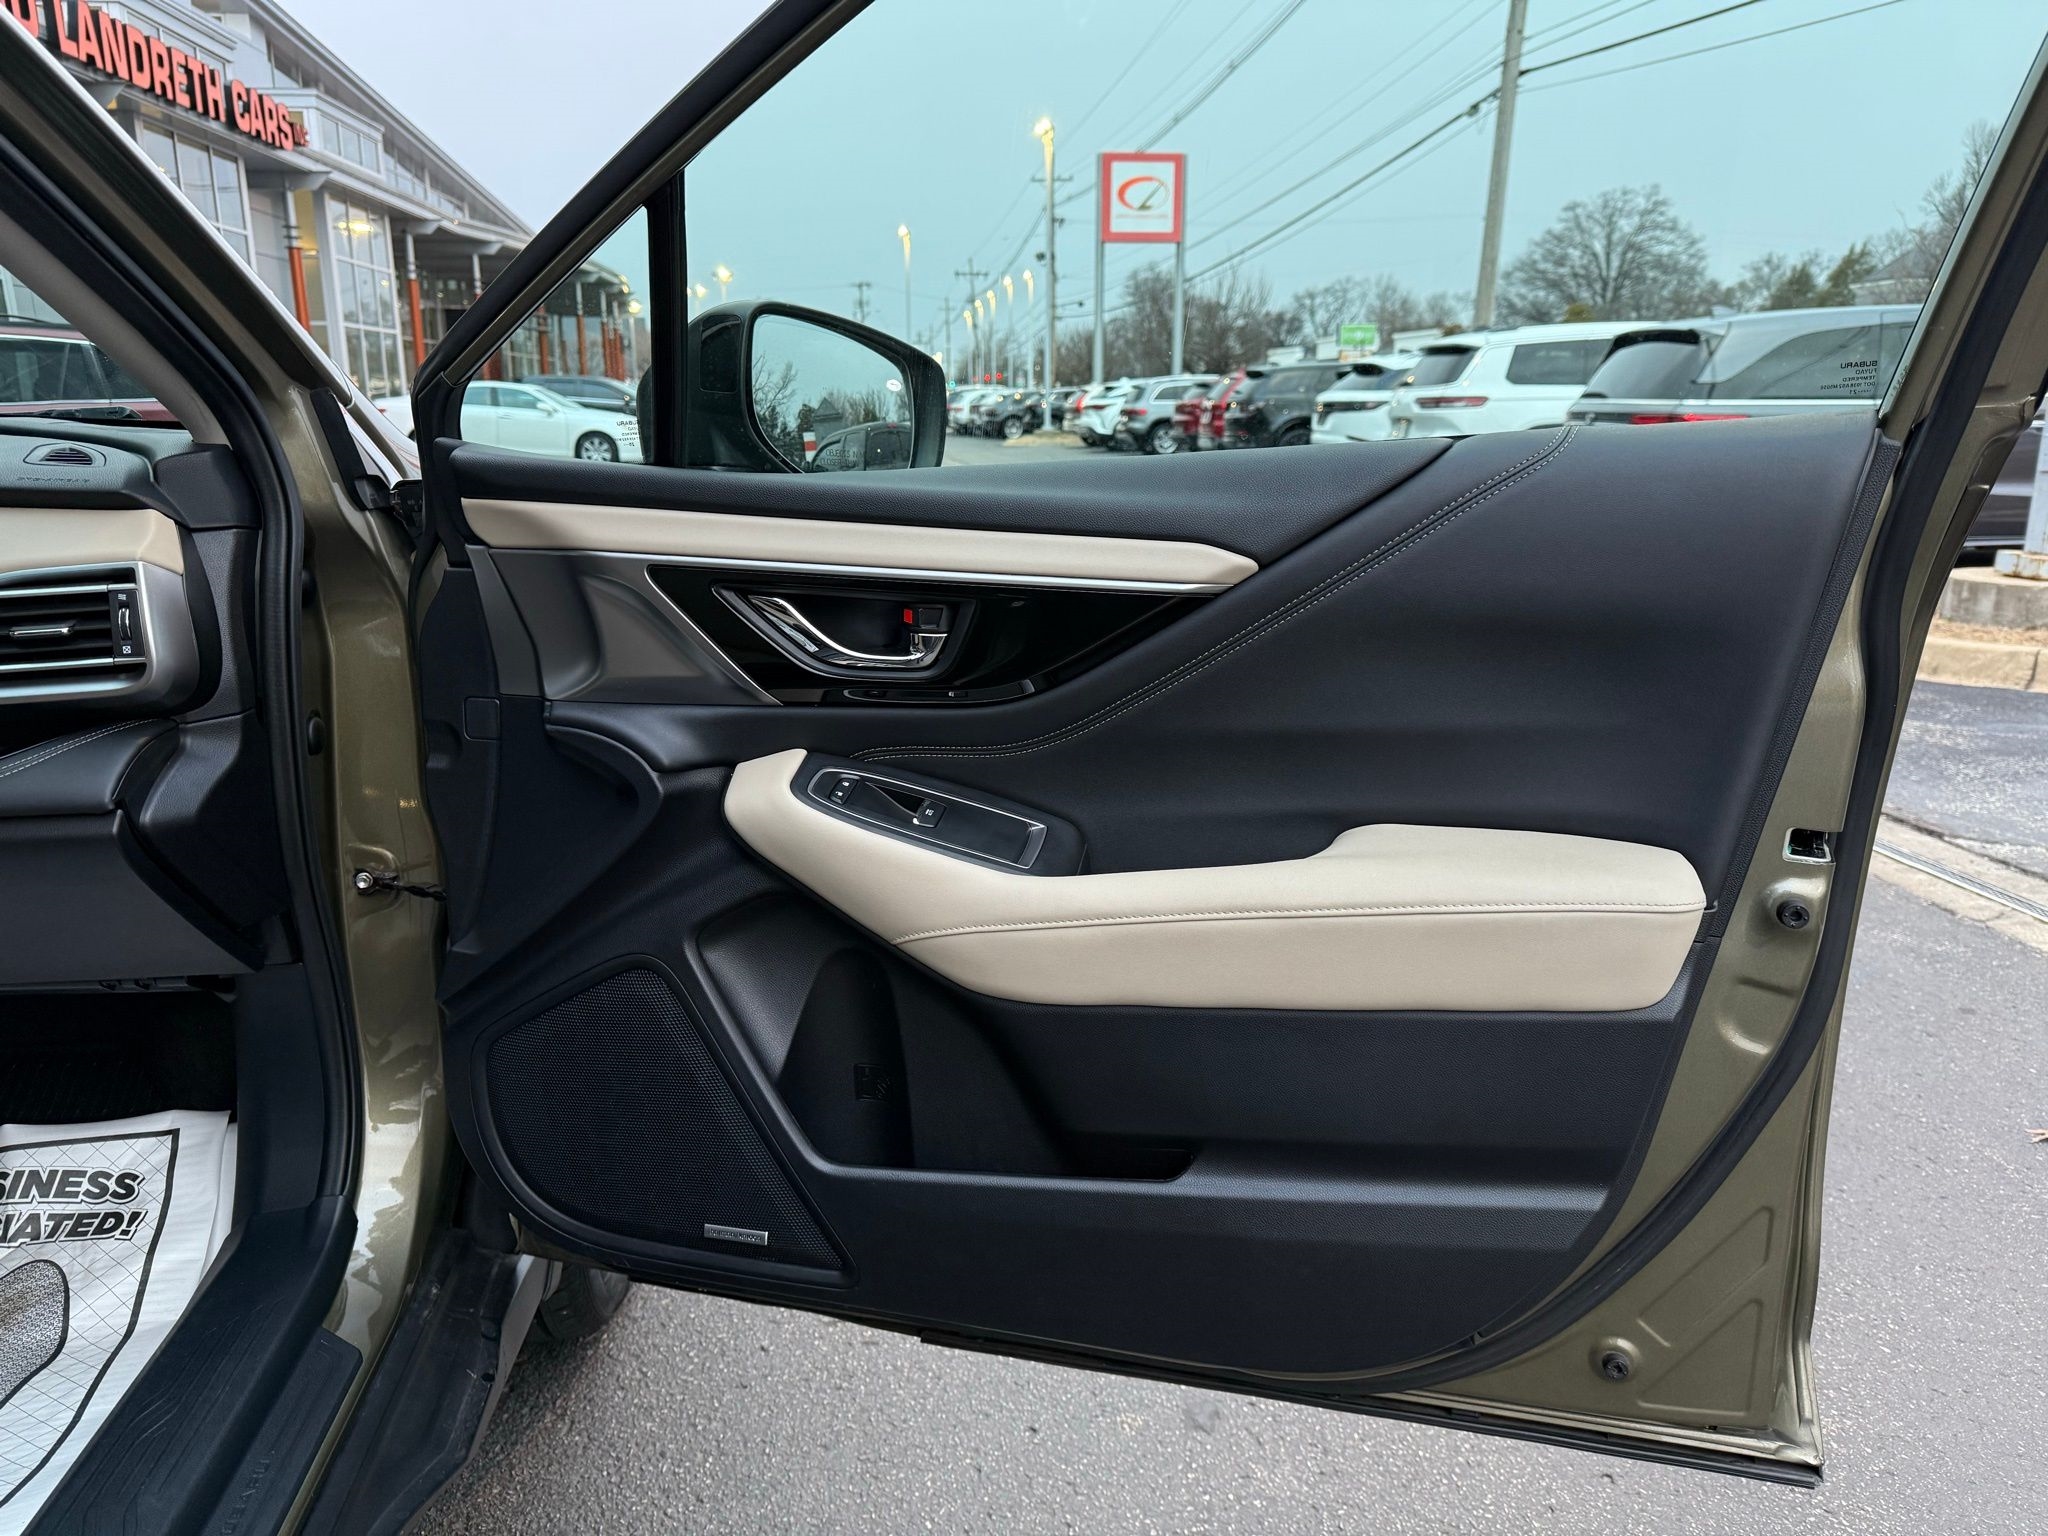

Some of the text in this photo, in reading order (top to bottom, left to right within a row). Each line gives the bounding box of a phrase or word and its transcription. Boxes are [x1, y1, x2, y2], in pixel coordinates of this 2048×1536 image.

[53, 0, 226, 123] LANDRETH
[231, 79, 294, 151] CARS
[0, 1210, 145, 1244] IATED!
